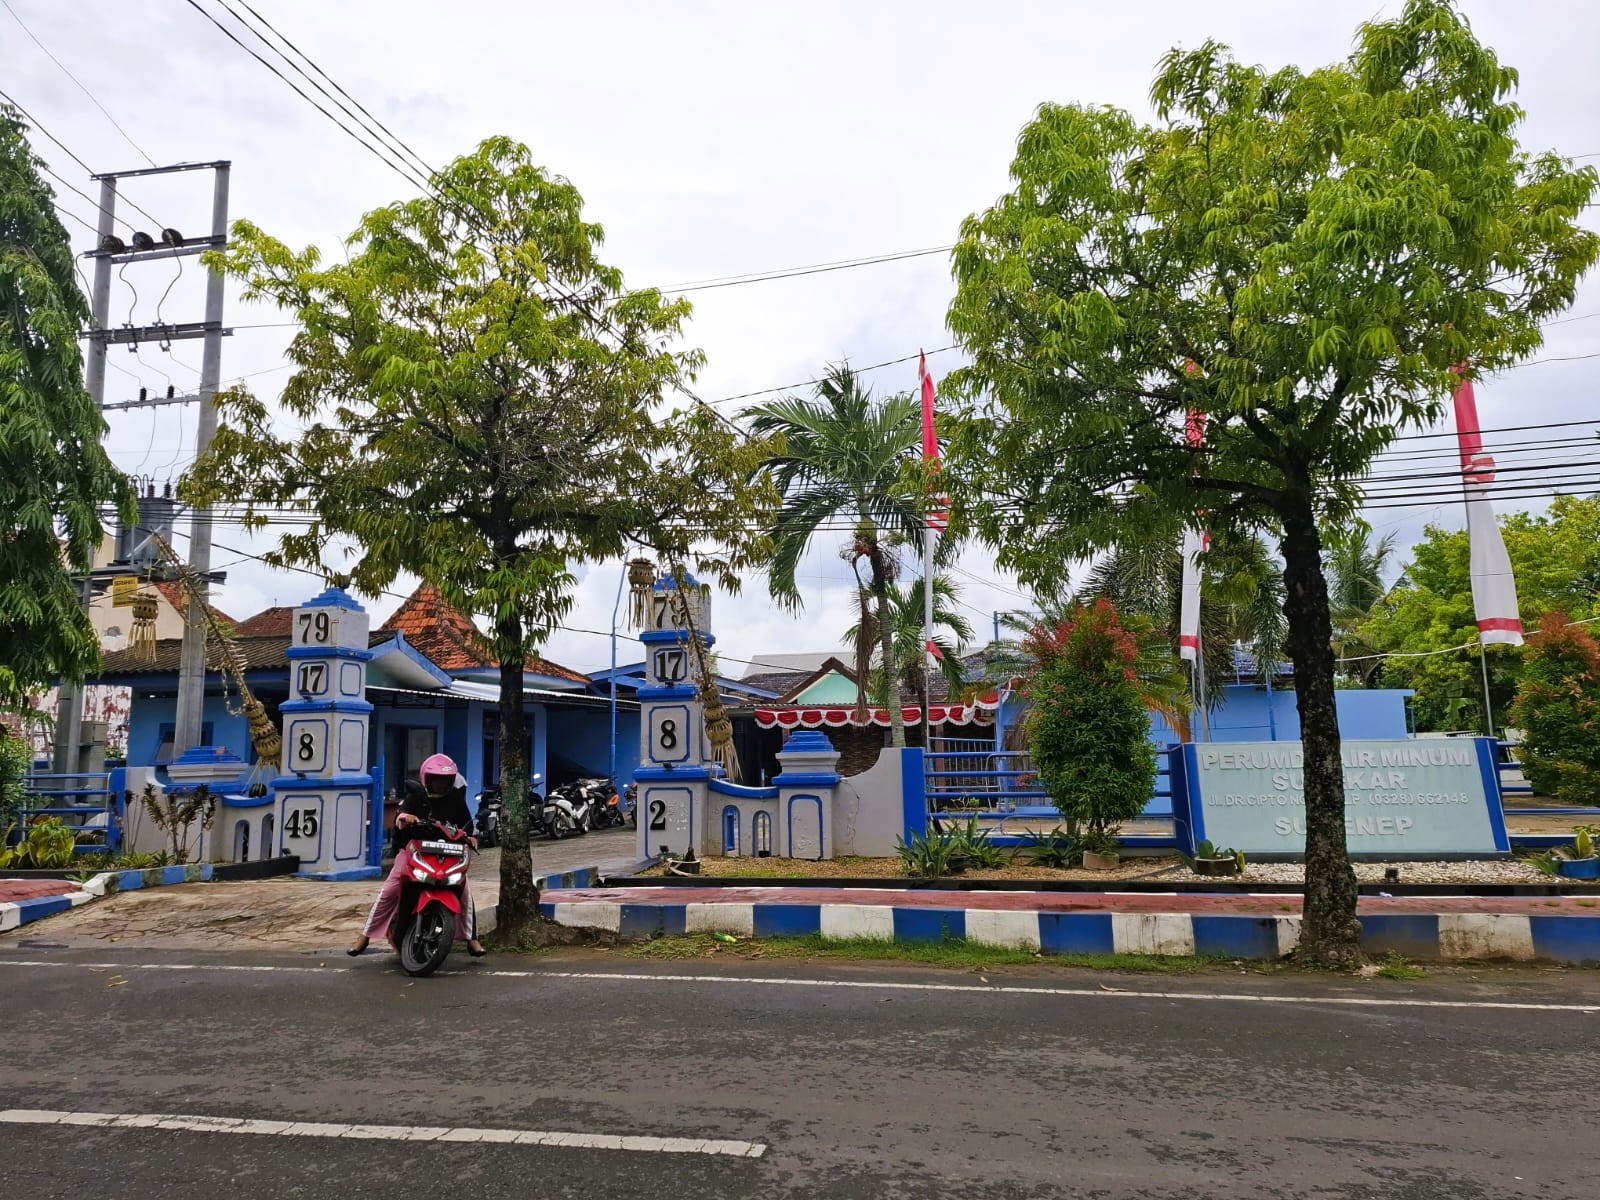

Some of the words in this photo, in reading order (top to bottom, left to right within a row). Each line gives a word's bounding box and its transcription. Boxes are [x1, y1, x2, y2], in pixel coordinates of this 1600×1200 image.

[299, 612, 330, 643] 79
[300, 665, 324, 694] 17
[657, 651, 683, 682] 17
[299, 733, 314, 761] 8
[660, 719, 677, 749] 8
[1202, 751, 1304, 770] PERUMD
[1380, 748, 1472, 767] MINUM
[1272, 771, 1408, 790] SUKAR
[284, 808, 318, 838] 45
[649, 800, 666, 831] 2
[1274, 815, 1413, 836] SUENEP
